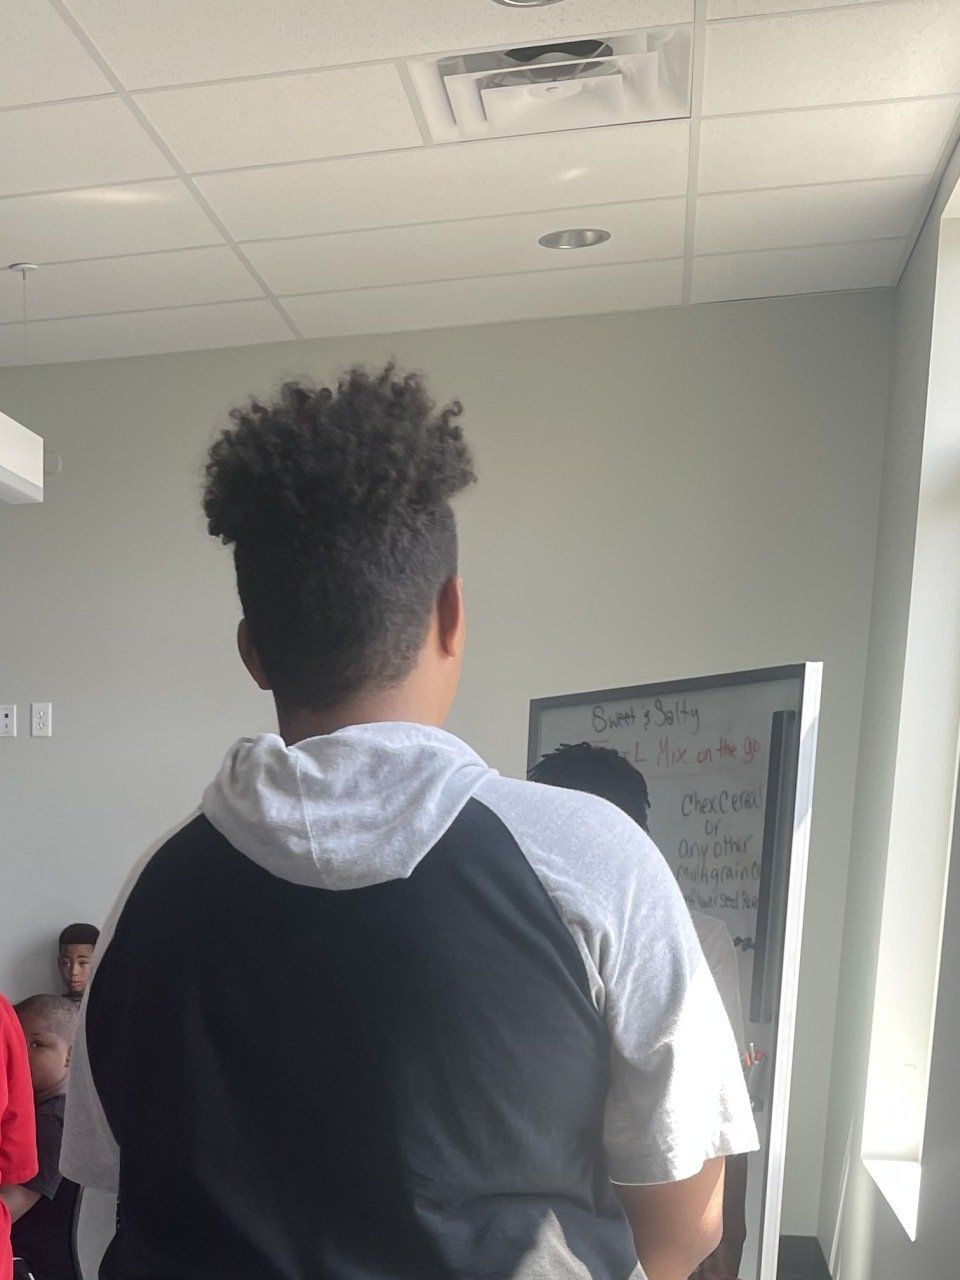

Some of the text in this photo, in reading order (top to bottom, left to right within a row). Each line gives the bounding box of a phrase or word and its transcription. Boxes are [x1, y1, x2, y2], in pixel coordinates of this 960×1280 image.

[654, 698, 700, 736] Salty
[657, 736, 688, 768] Mix
[697, 748, 713, 764] on
[716, 735, 737, 759] the
